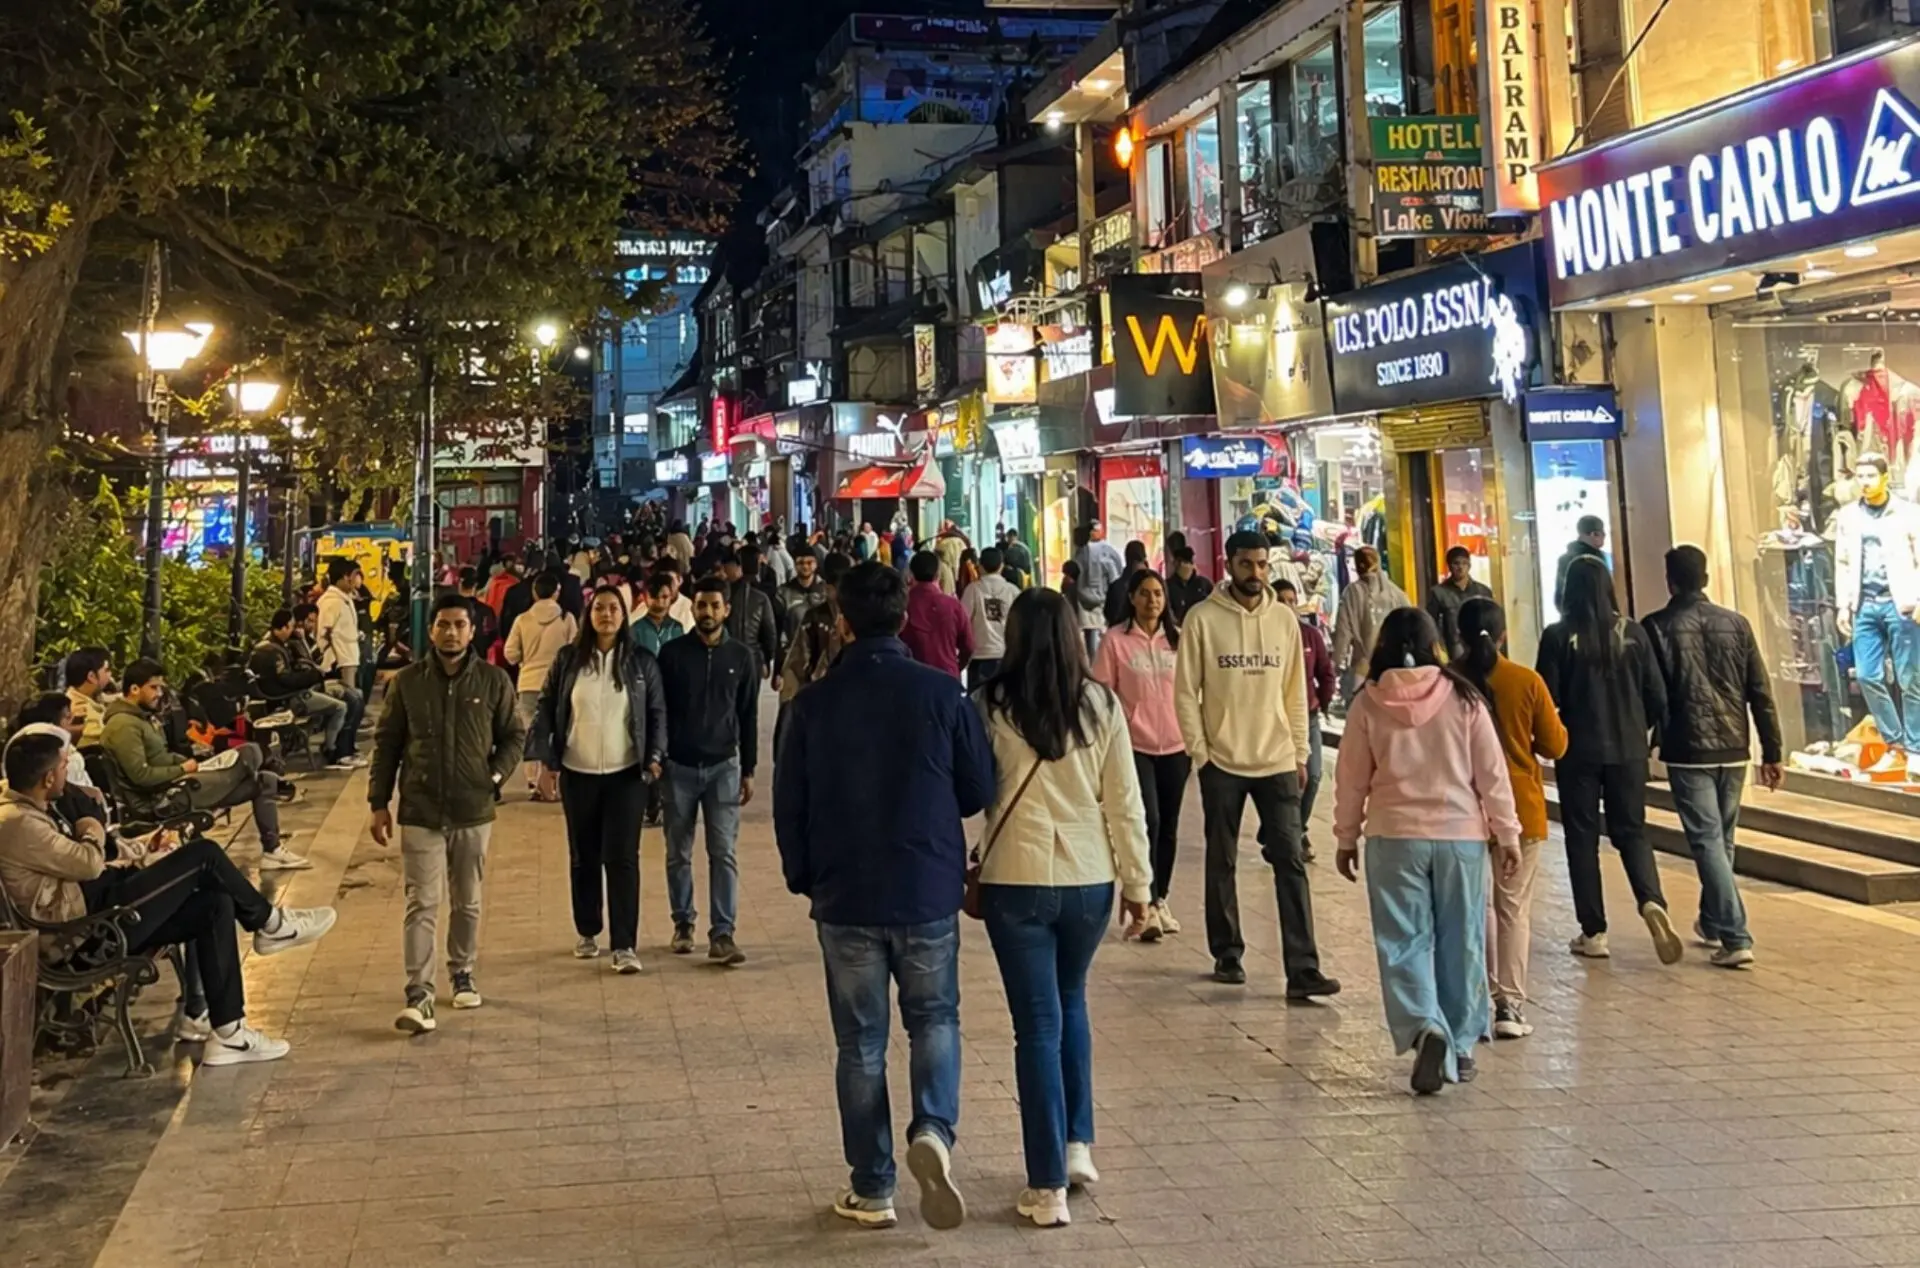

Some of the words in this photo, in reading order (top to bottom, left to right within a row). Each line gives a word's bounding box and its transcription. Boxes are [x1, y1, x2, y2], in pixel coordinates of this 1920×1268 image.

[1500, 6, 1530, 185] BALRAMP
[1388, 123, 1473, 150] HOTEL
[1383, 207, 1433, 232] Lake
[1550, 165, 1681, 280] MONTE
[1688, 116, 1842, 244] CARLO
[1126, 314, 1207, 377] W
[1333, 313, 1365, 354] U.S.
[1366, 297, 1418, 348] POLO
[1376, 356, 1413, 387] SINCE
[1414, 351, 1444, 380] 1890
